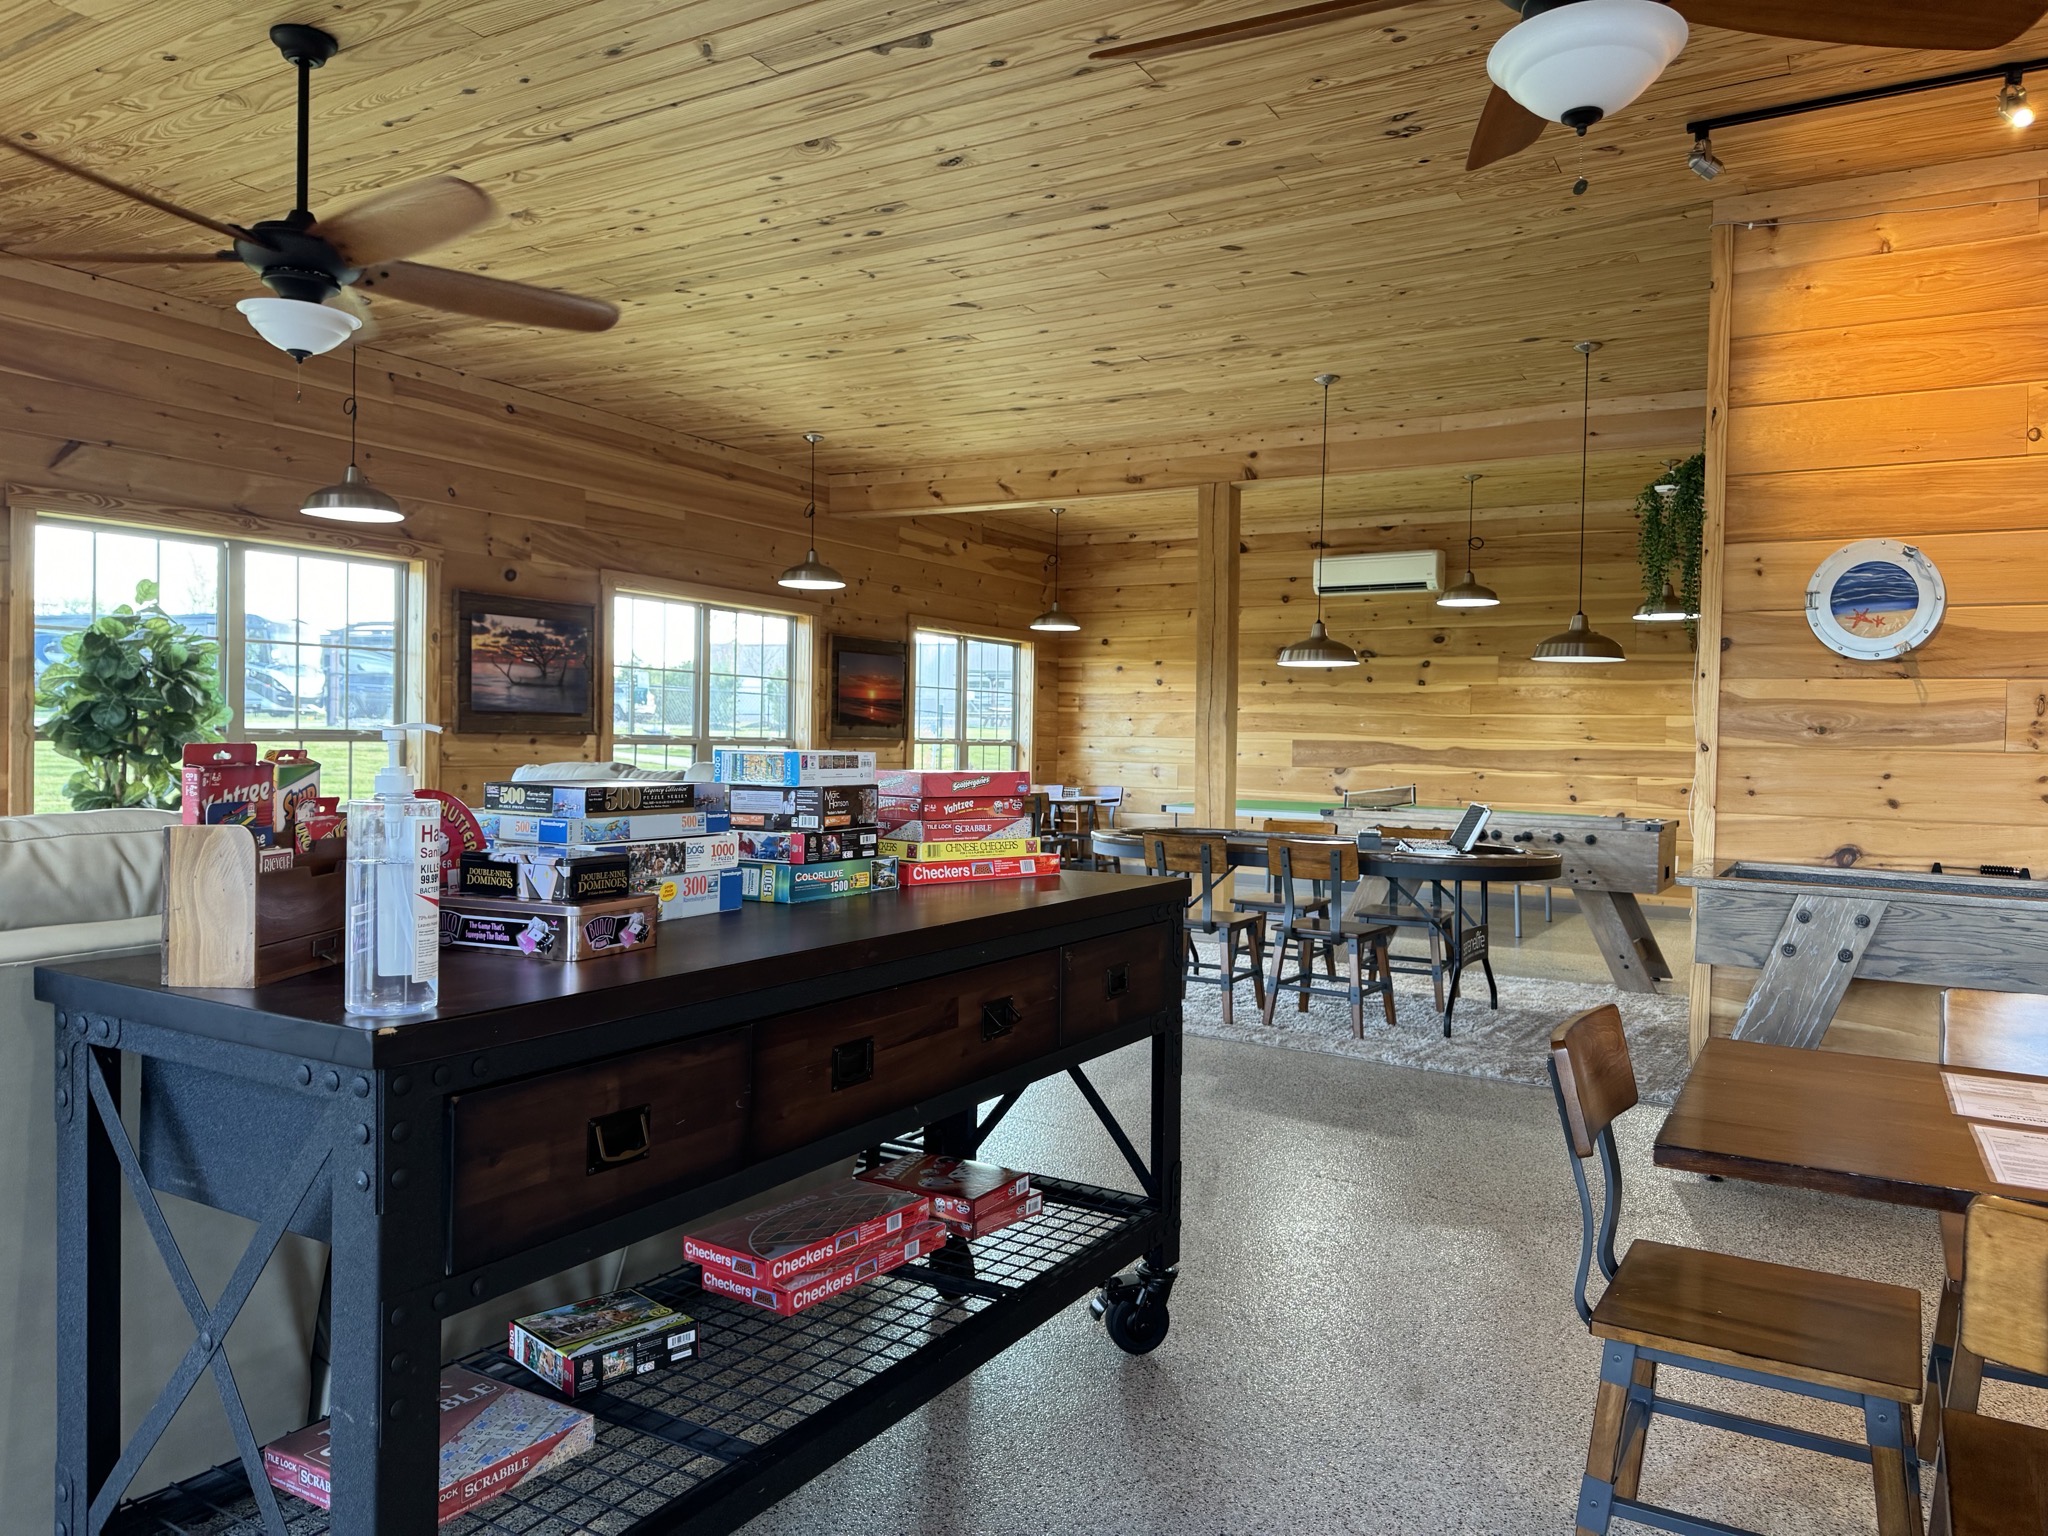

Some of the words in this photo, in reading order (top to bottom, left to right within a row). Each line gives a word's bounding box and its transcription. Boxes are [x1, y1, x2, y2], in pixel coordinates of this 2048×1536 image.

[500, 786, 526, 805] 500
[605, 787, 641, 811] 500
[824, 790, 840, 801] Marc
[828, 799, 850, 809] Hanson
[943, 800, 974, 815] Yahtzee
[441, 800, 477, 851] HUTTER
[515, 821, 530, 832] 500
[682, 816, 696, 828] 500
[954, 824, 992, 833] SCRABBLE
[422, 824, 439, 843] Ha
[711, 843, 735, 857] 1000
[878, 842, 897, 852] CKERS
[946, 843, 978, 852] CHINESE
[980, 841, 1018, 851] CHECKERS
[469, 867, 511, 878] DOUBLE-NINE
[580, 870, 626, 881] DOUBLE-NINE
[795, 870, 844, 882] COLORLUXE
[913, 865, 970, 880] Checkers
[466, 874, 513, 889] DOMINOES
[578, 877, 628, 894] DOMINOES
[683, 875, 707, 897] 300
[763, 869, 774, 897] 1500
[830, 880, 848, 892] 1500
[478, 922, 490, 930] Game
[588, 918, 613, 938] BUNCO
[486, 932, 494, 940] The
[685, 1242, 731, 1267] Checkers
[772, 1245, 833, 1278] Checkers
[704, 1272, 751, 1297] Checkers
[793, 1273, 852, 1308] Checkers
[268, 1453, 279, 1465] TILE
[280, 1459, 297, 1472] LOCK
[301, 1469, 330, 1492] SCRAB
[439, 1487, 458, 1503] OCK
[464, 1456, 530, 1498] SCRABBLE
